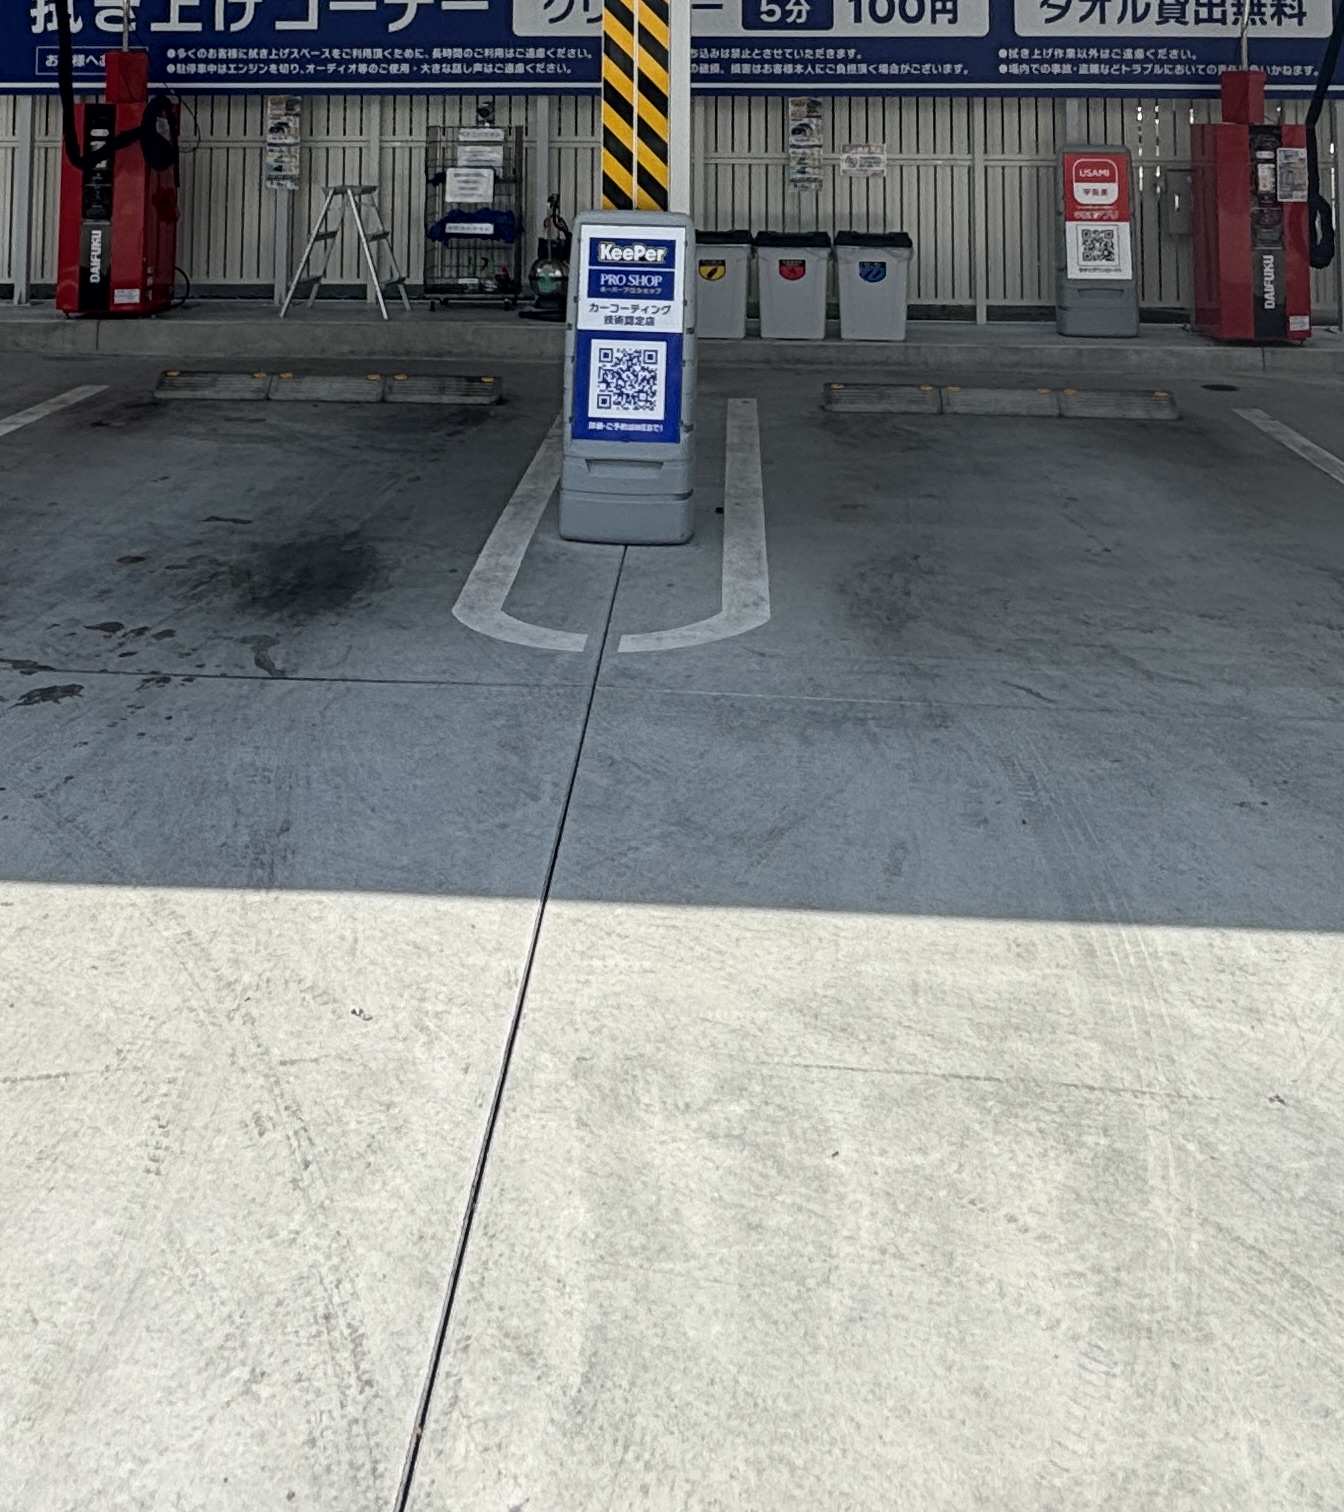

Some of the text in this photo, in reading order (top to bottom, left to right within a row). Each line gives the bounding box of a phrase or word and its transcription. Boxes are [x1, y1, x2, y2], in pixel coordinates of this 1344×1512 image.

[1079, 168, 1110, 178] USAMI
[89, 230, 103, 285] DAIFUKU
[598, 242, 666, 264] KeePer
[600, 273, 663, 287] PRO SHOP
[1263, 254, 1275, 310] DAIFUKU
[588, 302, 672, 316] カーコーティング
